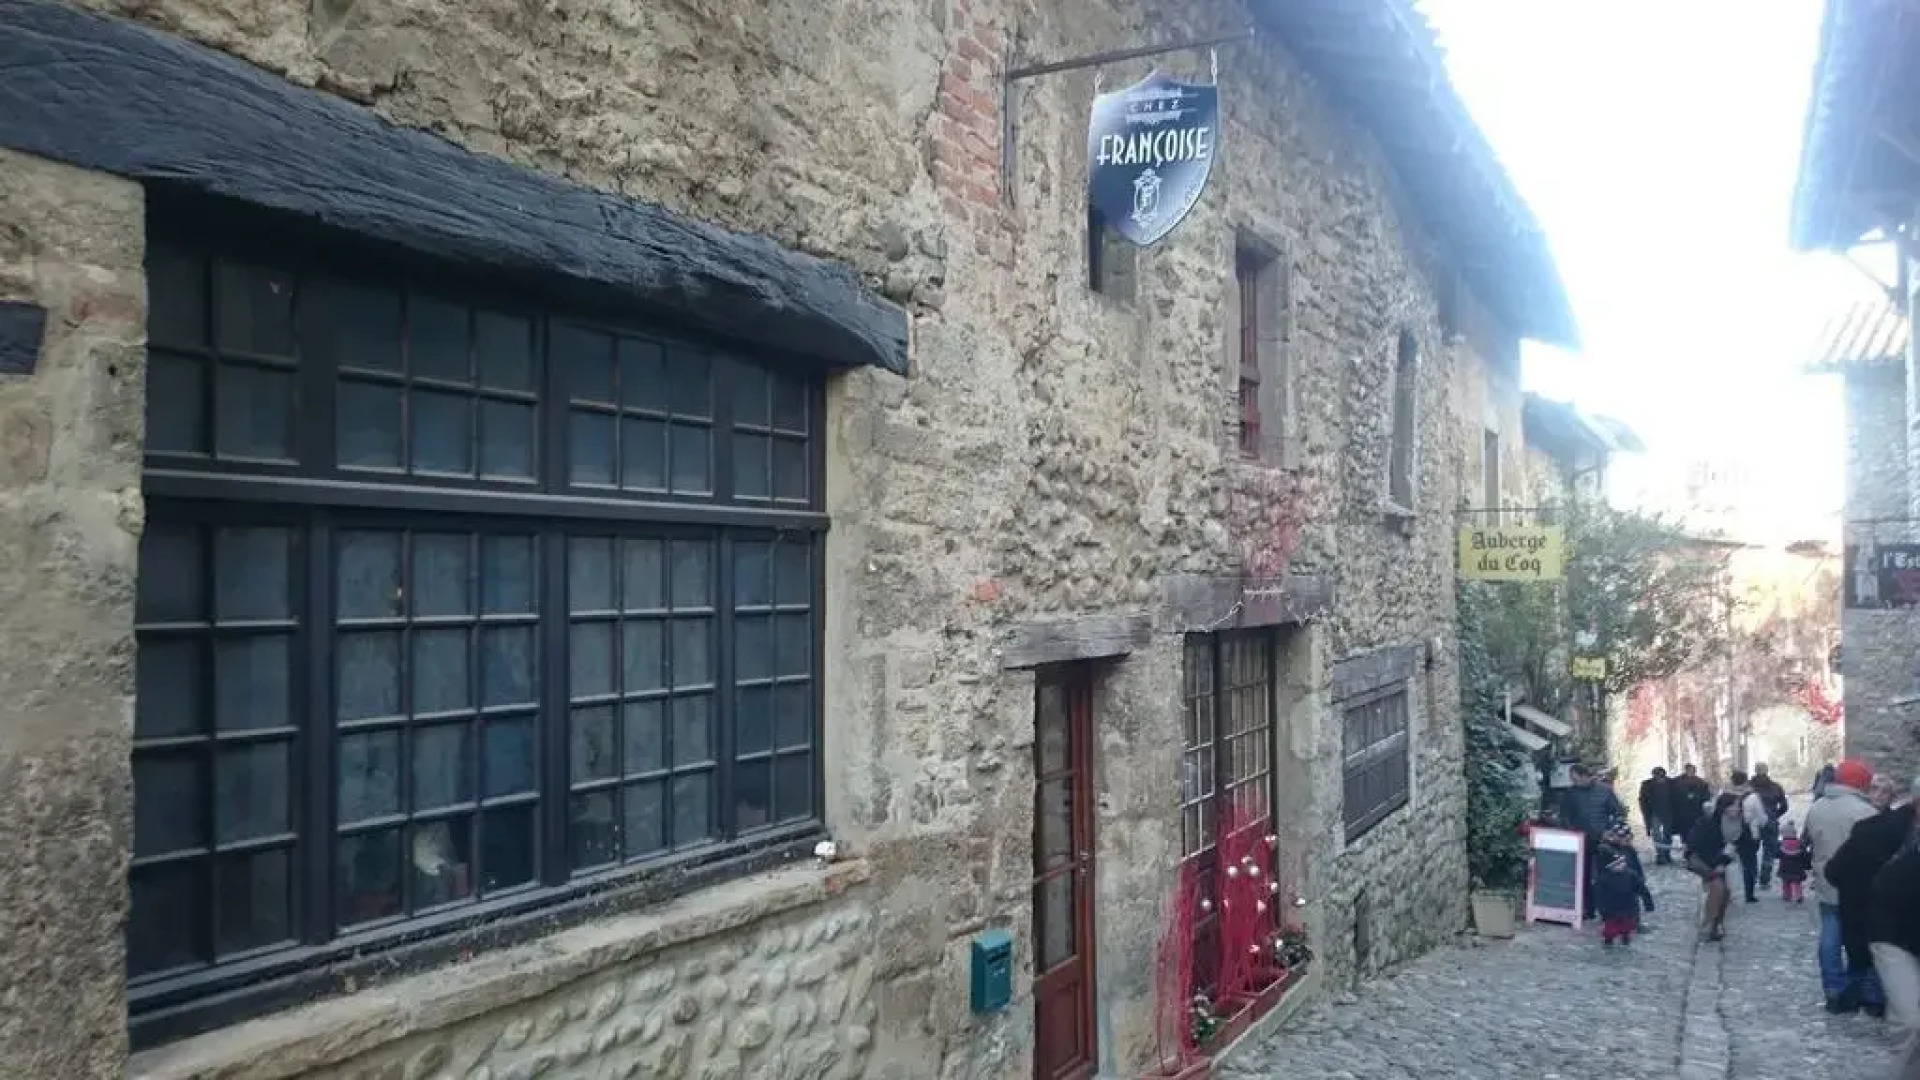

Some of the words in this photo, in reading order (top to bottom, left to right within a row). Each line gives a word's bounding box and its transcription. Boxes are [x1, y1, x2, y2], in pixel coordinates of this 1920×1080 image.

[1129, 99, 1182, 112] CHEZ
[1097, 127, 1209, 167] FRANÇOISE
[1471, 532, 1547, 555] Auberge
[1477, 554, 1499, 571] du
[1505, 553, 1541, 575] Coq
